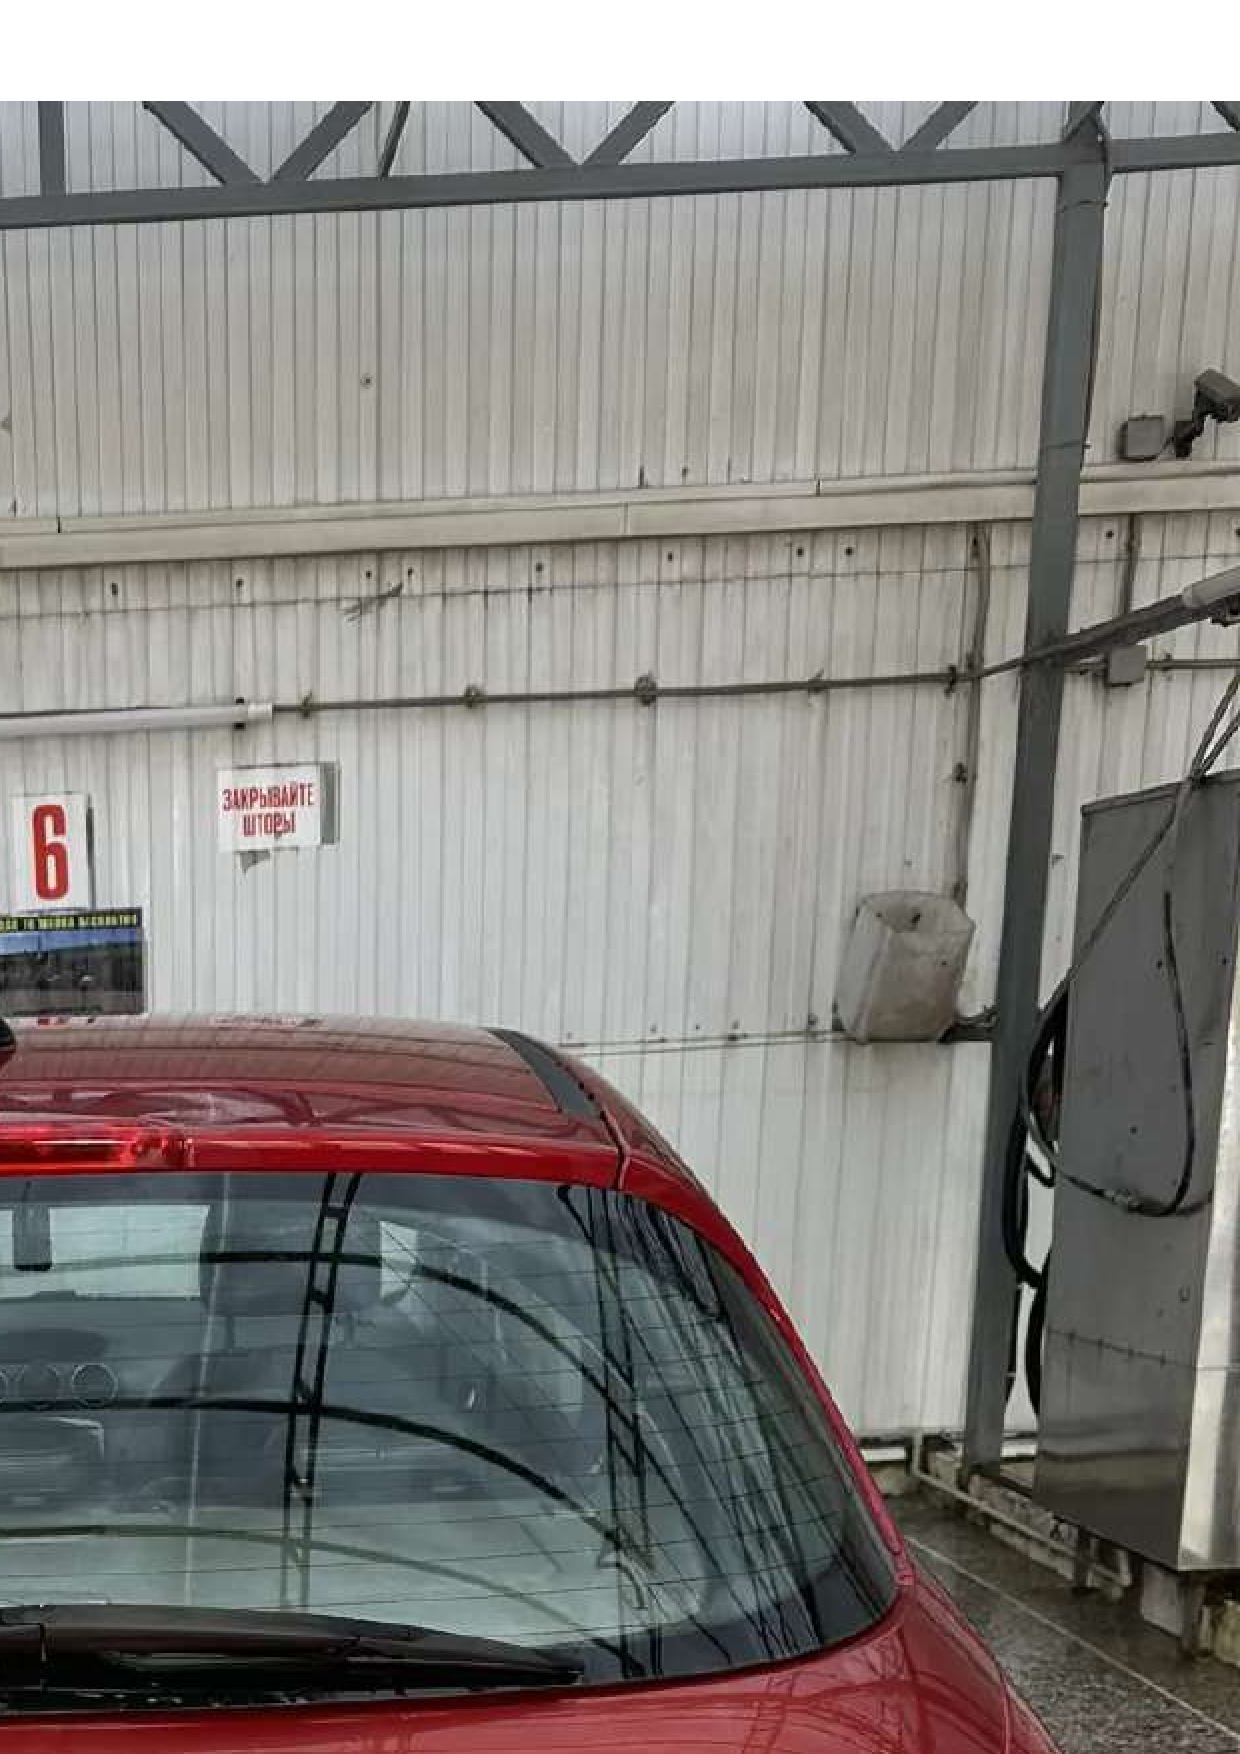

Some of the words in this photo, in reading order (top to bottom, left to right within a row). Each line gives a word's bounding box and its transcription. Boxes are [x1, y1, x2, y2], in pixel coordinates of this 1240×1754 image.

[222, 781, 314, 811] ЗАКРЫВАЙТЕ
[243, 812, 296, 837] ШТОРЫ
[32, 804, 69, 900] 6
